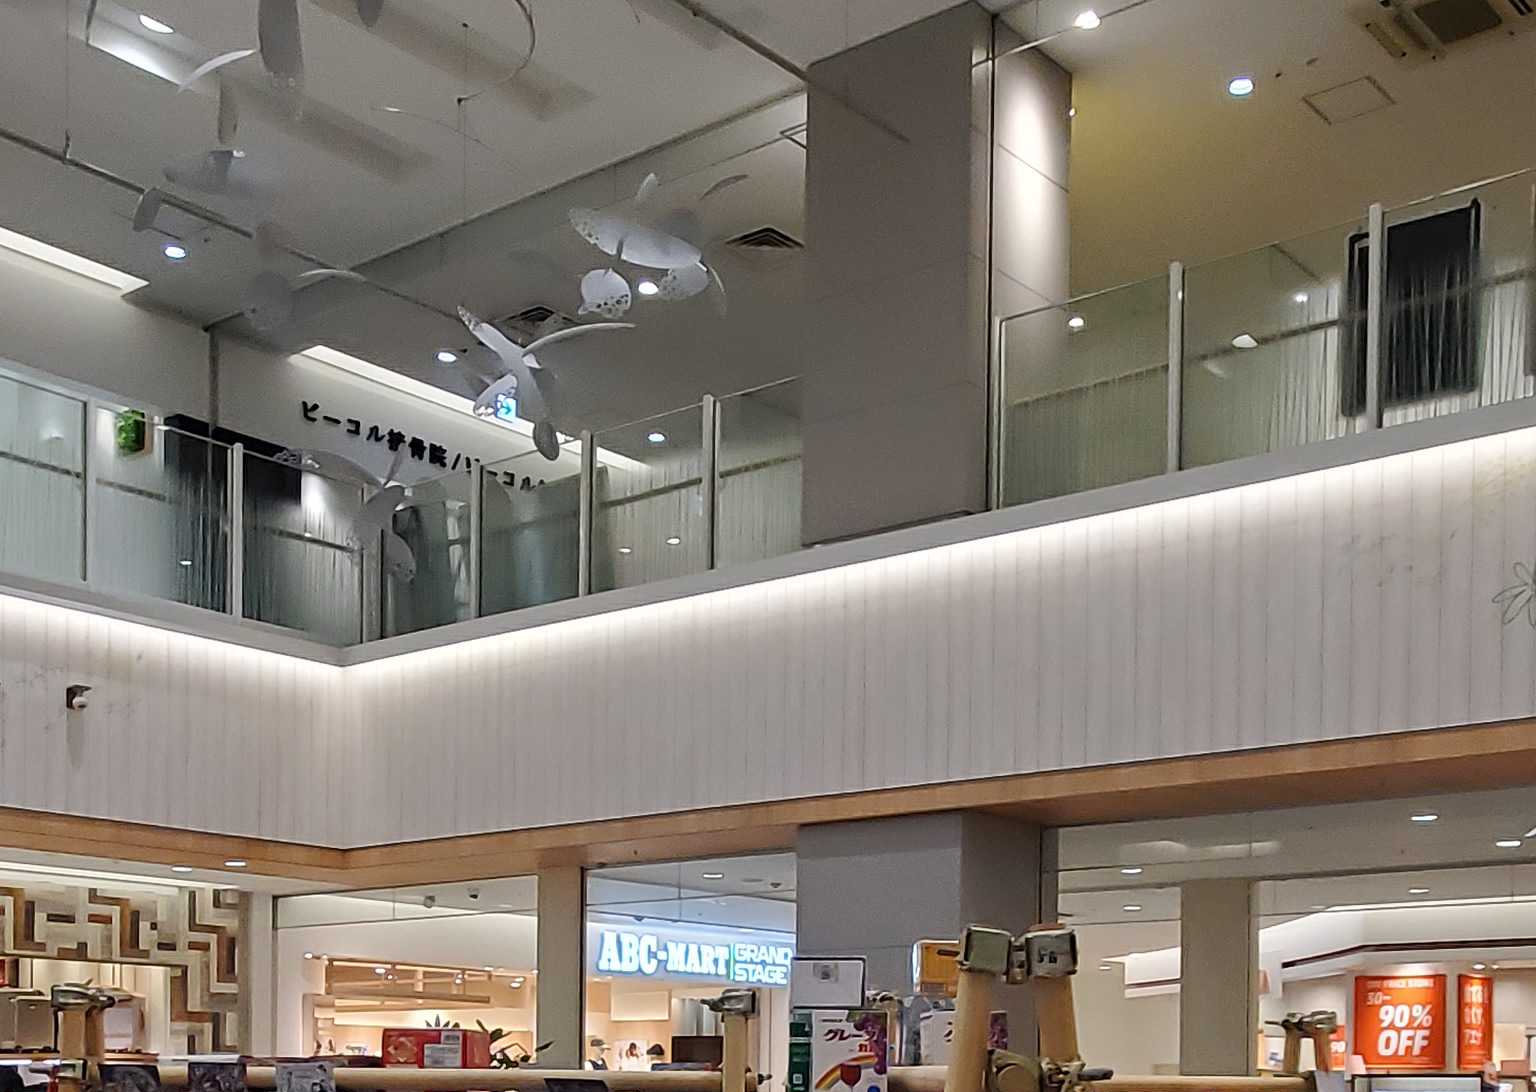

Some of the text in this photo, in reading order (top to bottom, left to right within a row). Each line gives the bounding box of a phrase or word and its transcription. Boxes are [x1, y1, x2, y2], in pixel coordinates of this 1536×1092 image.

[597, 930, 730, 976] ABC-MART
[735, 943, 792, 965] GRAND
[734, 964, 788, 985] STAGE
[1378, 1004, 1433, 1028] 90%
[1377, 1029, 1431, 1056] OFF
